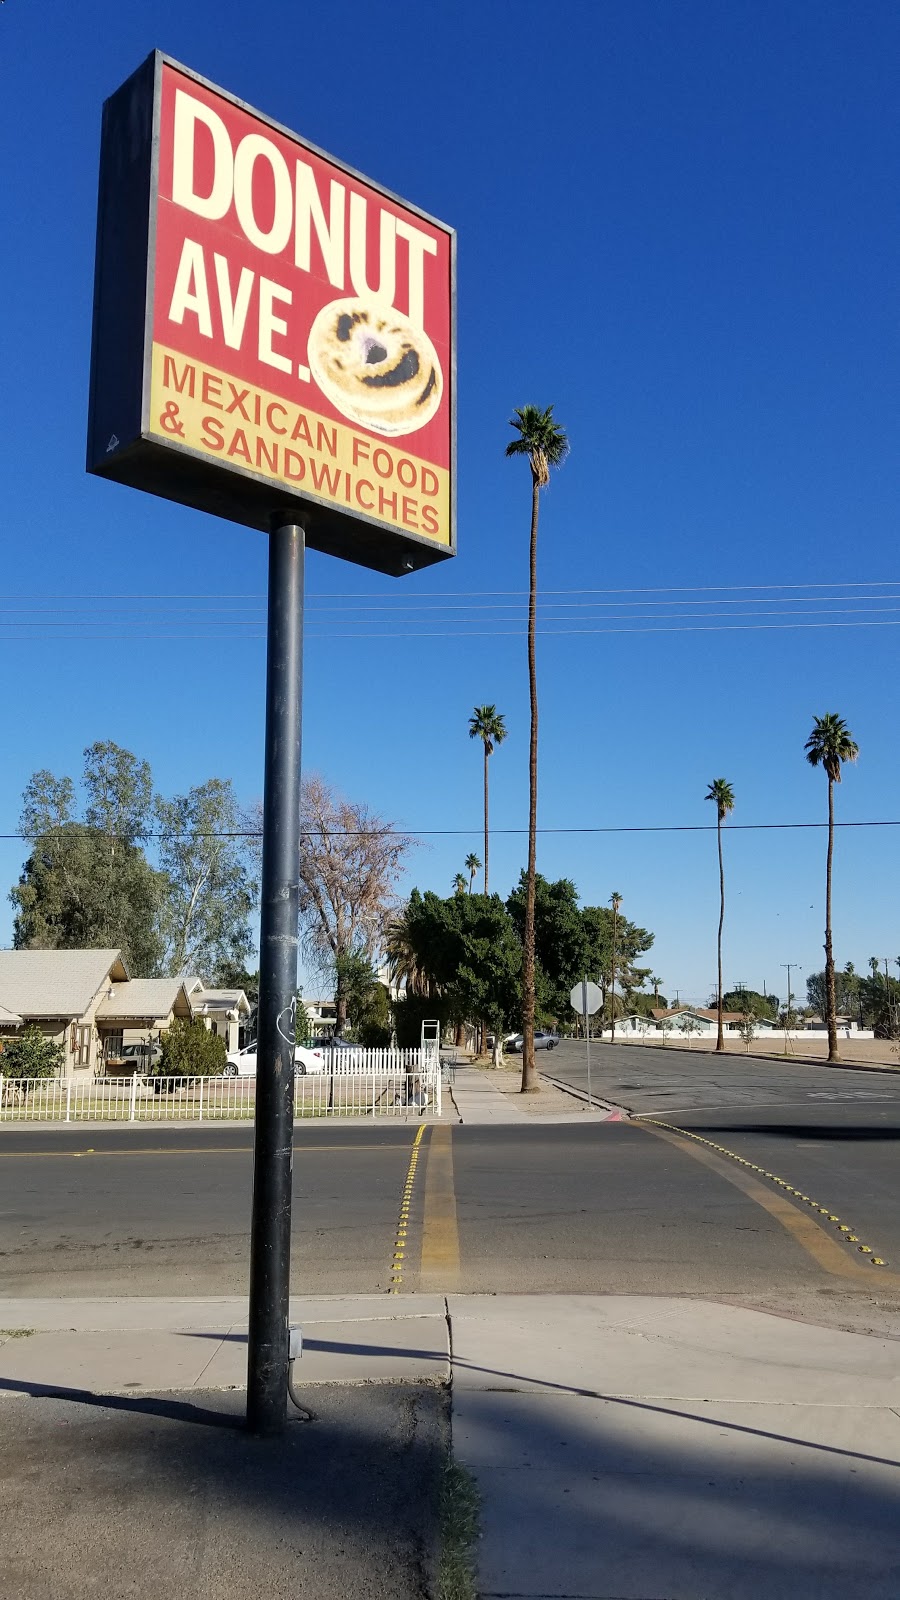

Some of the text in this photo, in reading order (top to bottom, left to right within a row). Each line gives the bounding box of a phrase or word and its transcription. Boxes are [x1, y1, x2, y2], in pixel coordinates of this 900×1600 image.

[172, 88, 438, 331] DONUT
[168, 237, 311, 383] AVE.
[159, 400, 440, 534] & SANDWICHES
[162, 354, 440, 497] MEXICAN FOOD
